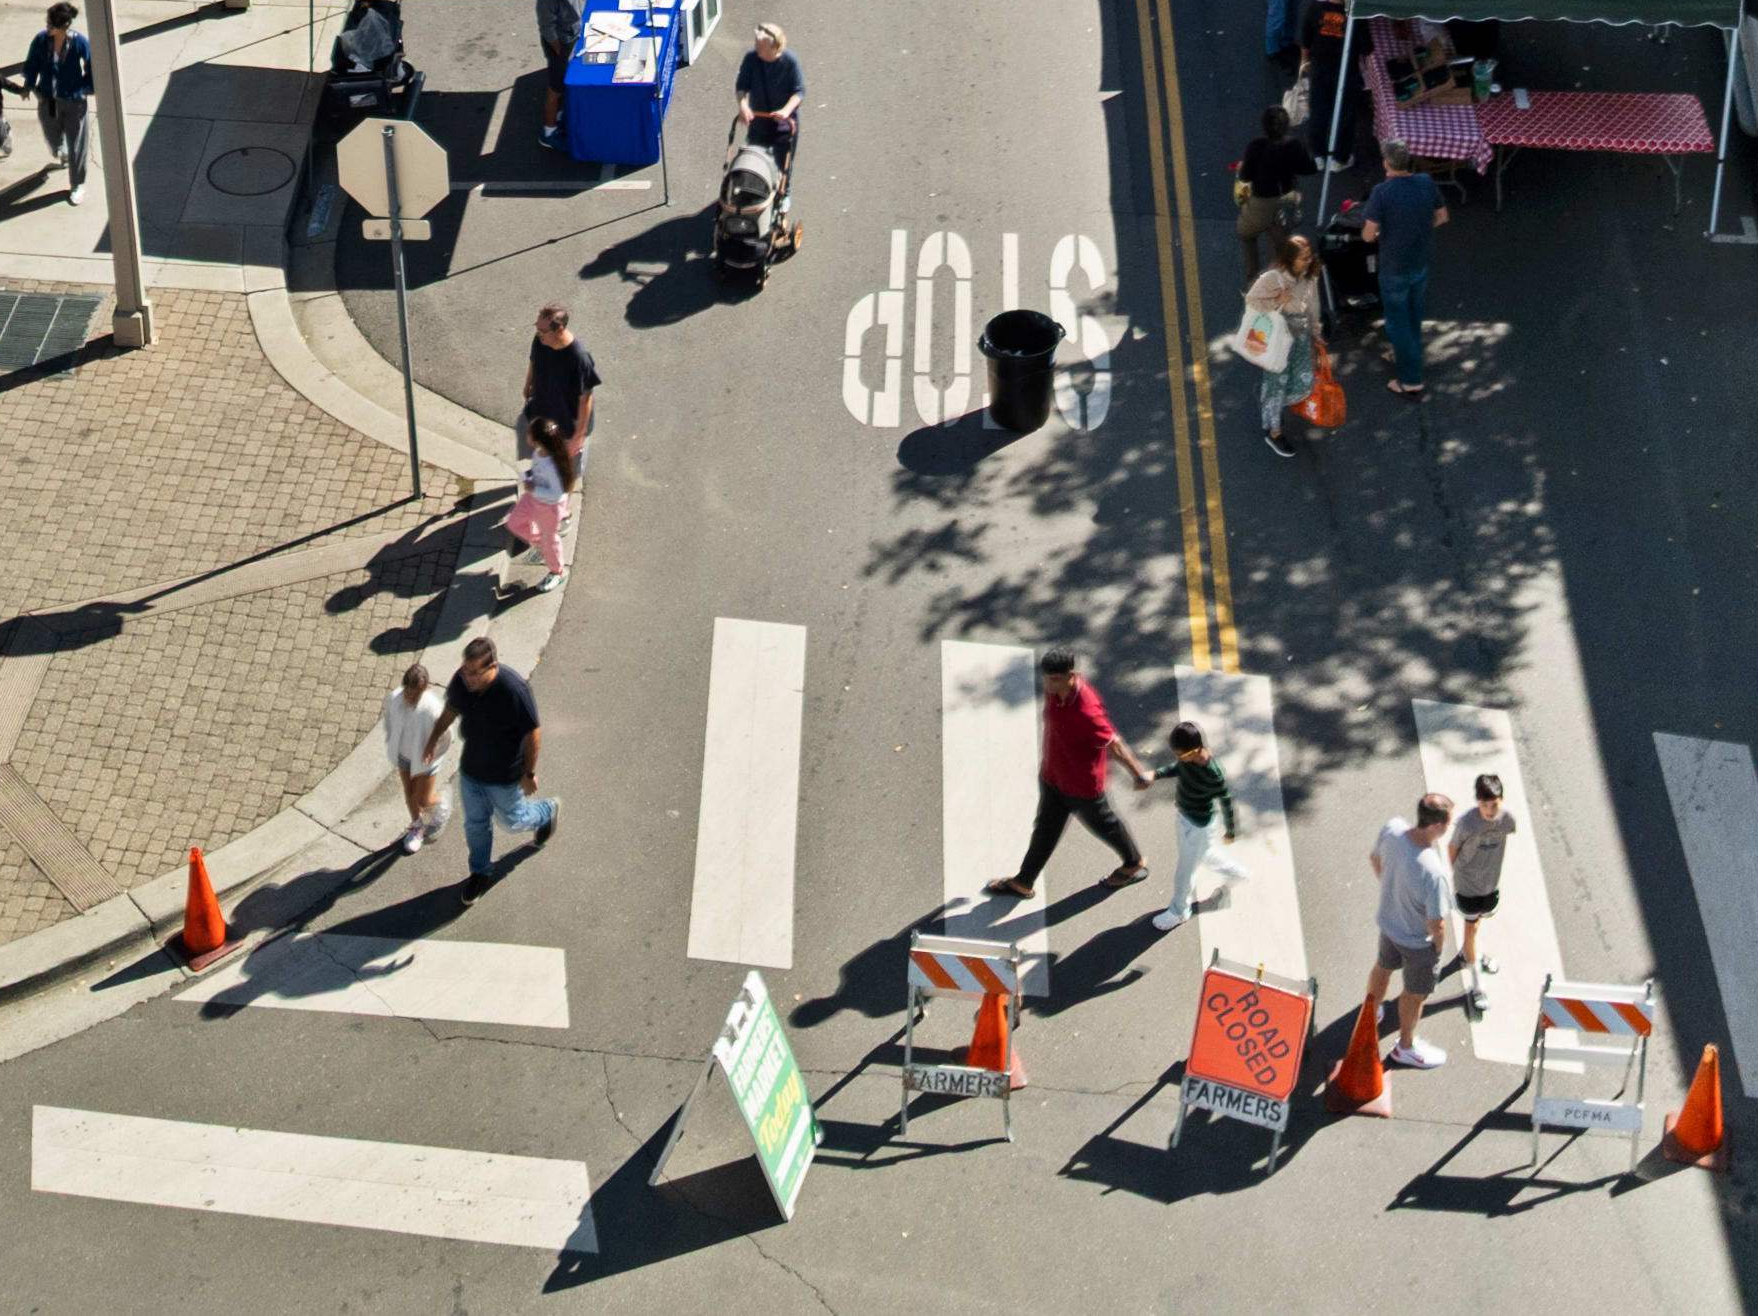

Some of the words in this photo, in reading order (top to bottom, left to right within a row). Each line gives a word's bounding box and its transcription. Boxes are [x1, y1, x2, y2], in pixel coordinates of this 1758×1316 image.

[1206, 991, 1278, 1086] CLOSED
[1235, 989, 1290, 1060] ROAD
[911, 1068, 1005, 1098] FARMERS
[1186, 1078, 1282, 1123] FARMERS
[1563, 1107, 1612, 1123] PCFMA
